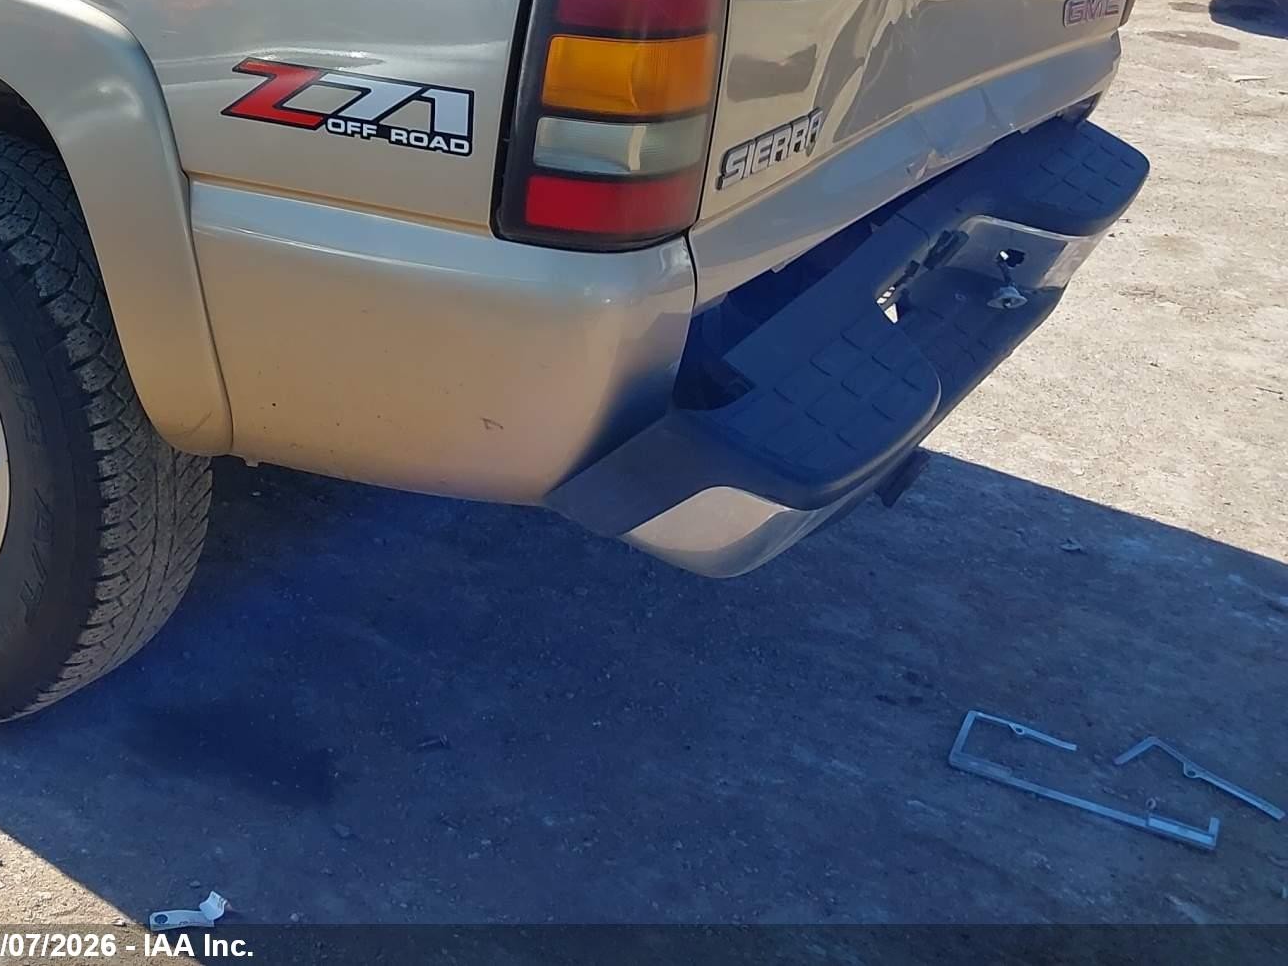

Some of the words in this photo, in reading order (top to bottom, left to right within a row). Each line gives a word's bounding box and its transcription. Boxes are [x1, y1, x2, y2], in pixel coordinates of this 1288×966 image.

[220, 57, 475, 139] Z71
[326, 117, 378, 138] OFF
[389, 127, 471, 155] ROAD
[716, 107, 823, 191] SIERRA
